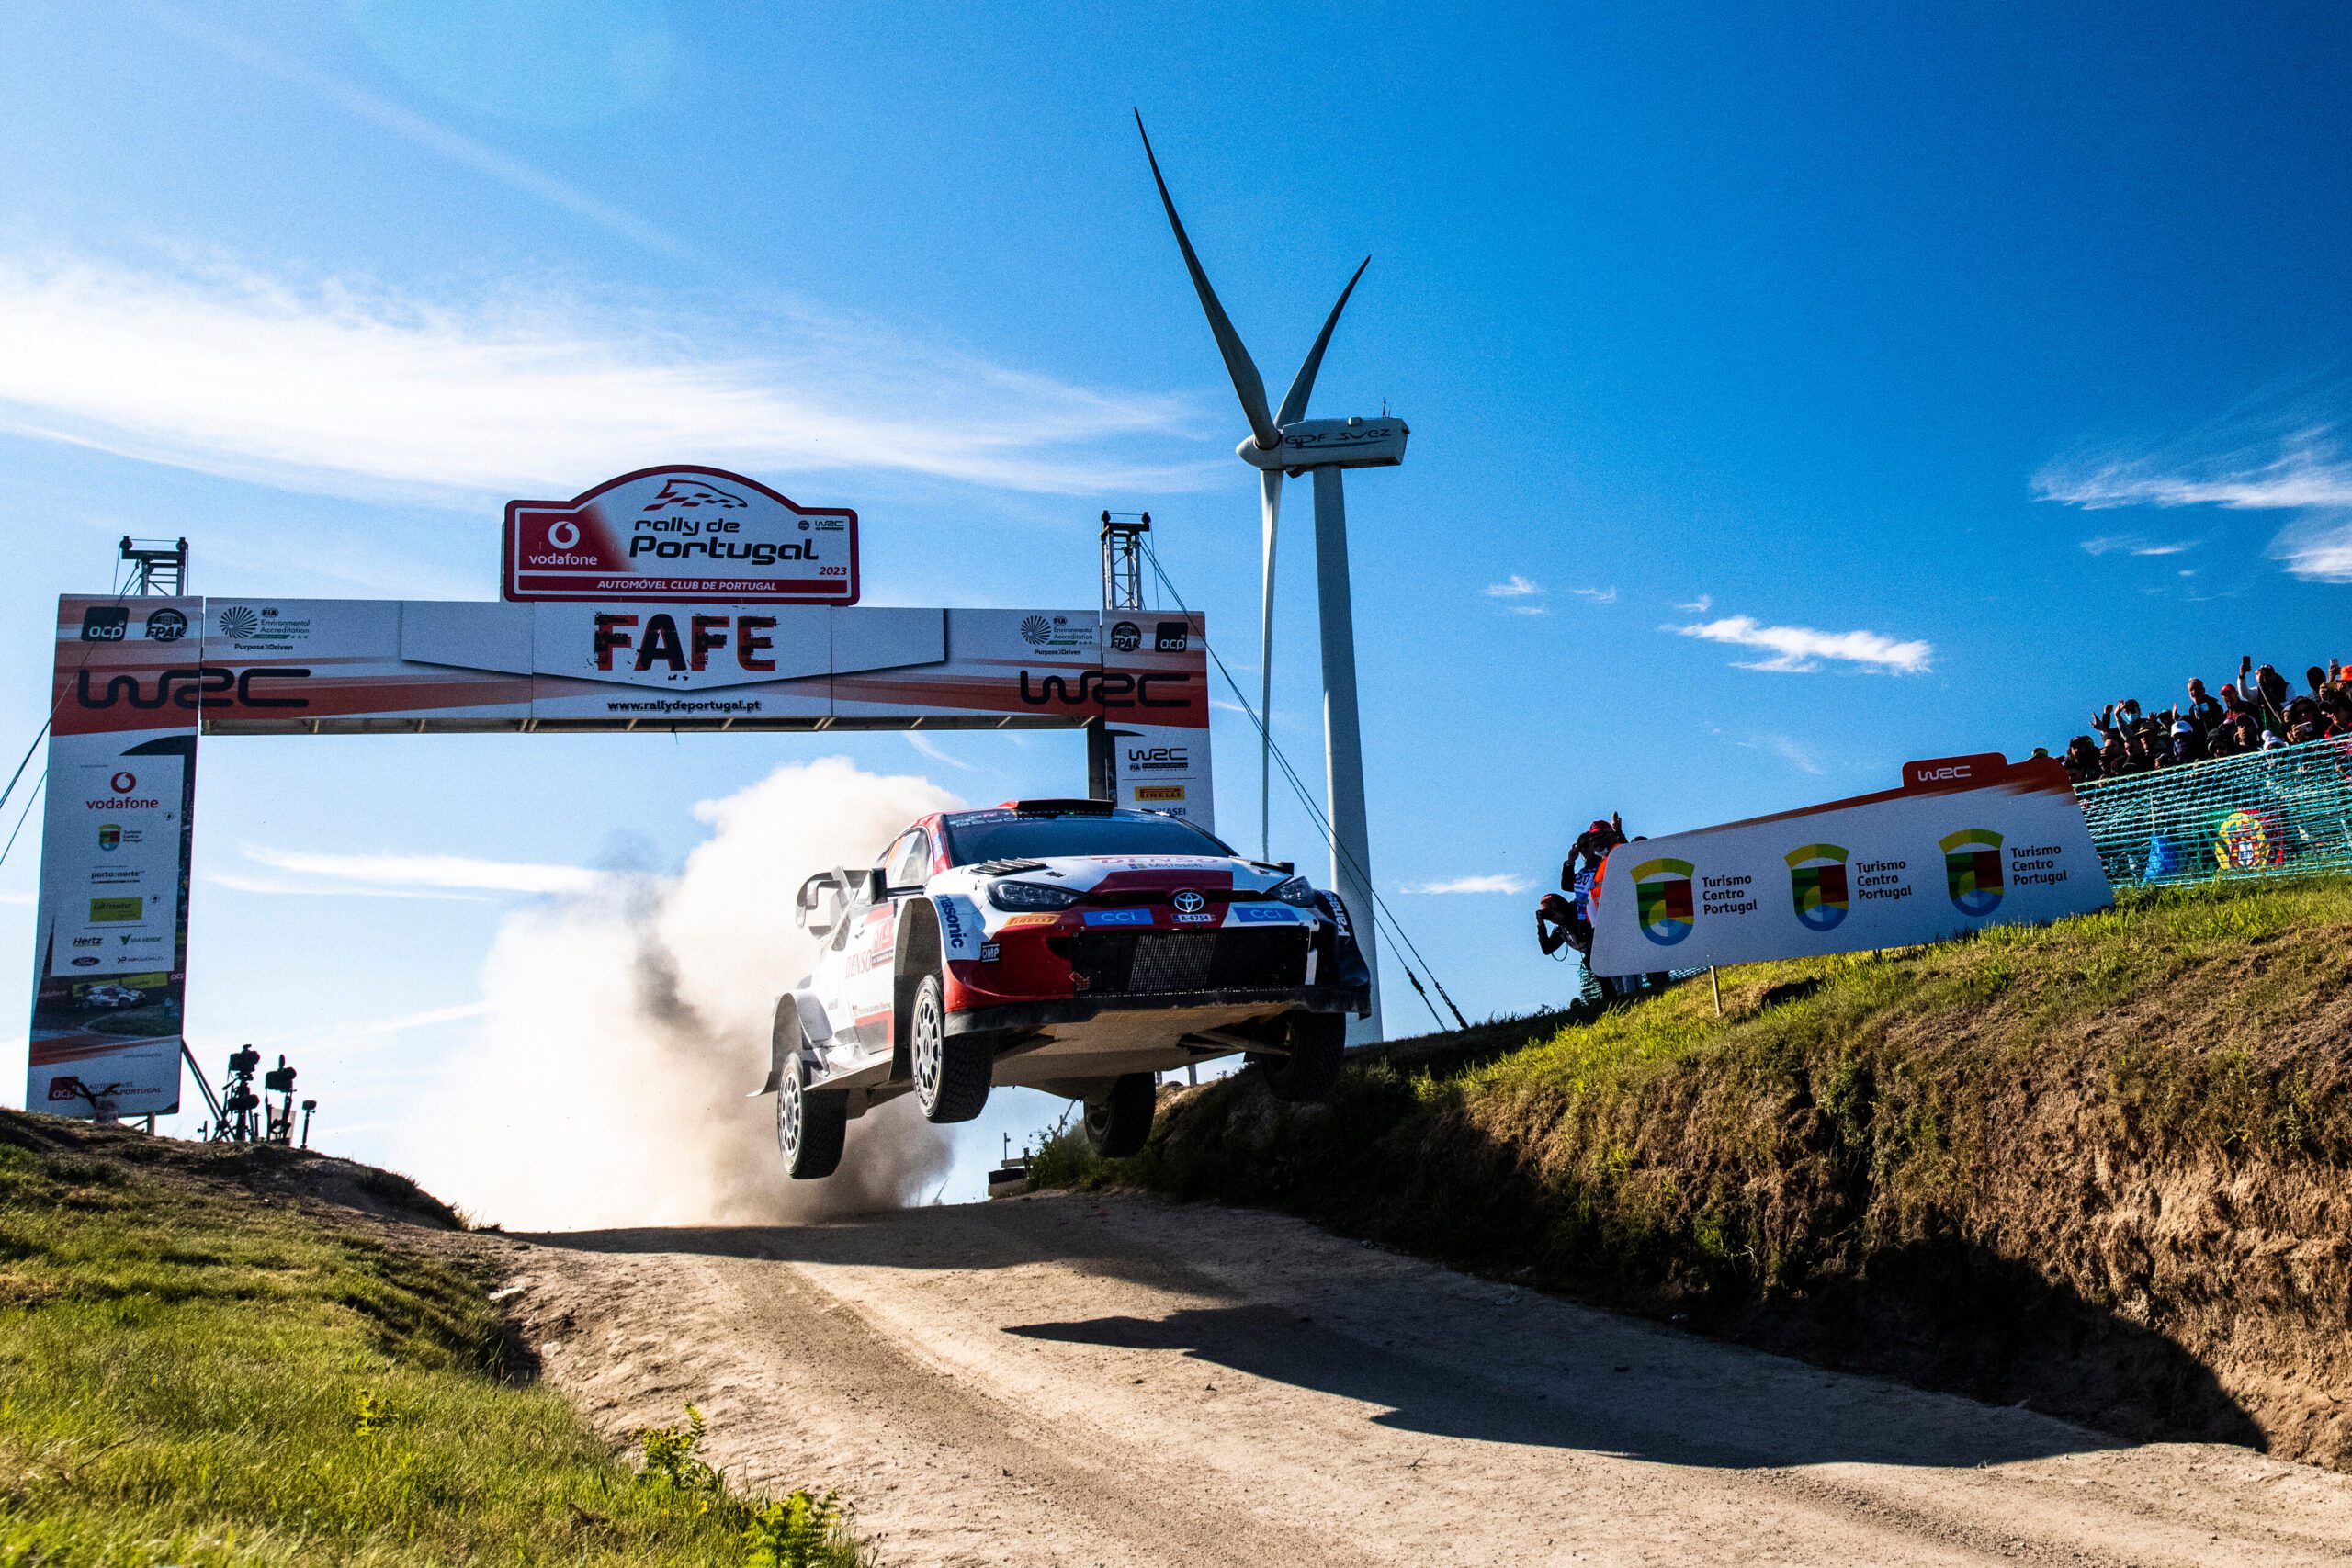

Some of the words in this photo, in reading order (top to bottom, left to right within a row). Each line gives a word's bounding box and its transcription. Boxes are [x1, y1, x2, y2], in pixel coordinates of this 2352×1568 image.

[635, 517, 700, 536] rally
[706, 517, 740, 533] de
[629, 536, 819, 565] Portugal
[529, 553, 597, 566] vodafone
[820, 566, 847, 575] 2023
[597, 579, 668, 590] AUTOMÓVEL
[671, 581, 699, 590] CLUB
[702, 581, 717, 590] DE
[719, 581, 776, 591] PORTUGAL
[89, 626, 123, 640] acp
[144, 626, 187, 638] FPAK
[594, 613, 777, 672] FAFE
[1110, 637, 1141, 649] FPAK
[1159, 639, 1185, 650] acp
[77, 668, 311, 709] WRC
[1020, 670, 1192, 708] WRC
[607, 700, 761, 713] www.rallydeportugal.pt
[1128, 748, 1188, 761] WRC
[1918, 766, 1972, 781] WRC
[1139, 788, 1181, 798] PIRELLI
[86, 796, 159, 809] vodafone
[2011, 845, 2061, 858] Turismo
[1856, 861, 1905, 874] Turismo
[2012, 859, 2053, 872] Centro
[1702, 874, 1751, 887] Turismo
[1858, 874, 1898, 886] Centro
[2013, 870, 2067, 885] Portugal
[1702, 888, 1744, 901] Centro
[1859, 885, 1912, 900] Portugal
[1704, 899, 1758, 915] Portugal
[1102, 911, 1136, 922] CCI
[1250, 909, 1282, 919] CCI
[74, 937, 103, 946] Hertz
[982, 947, 1000, 959] OMP
